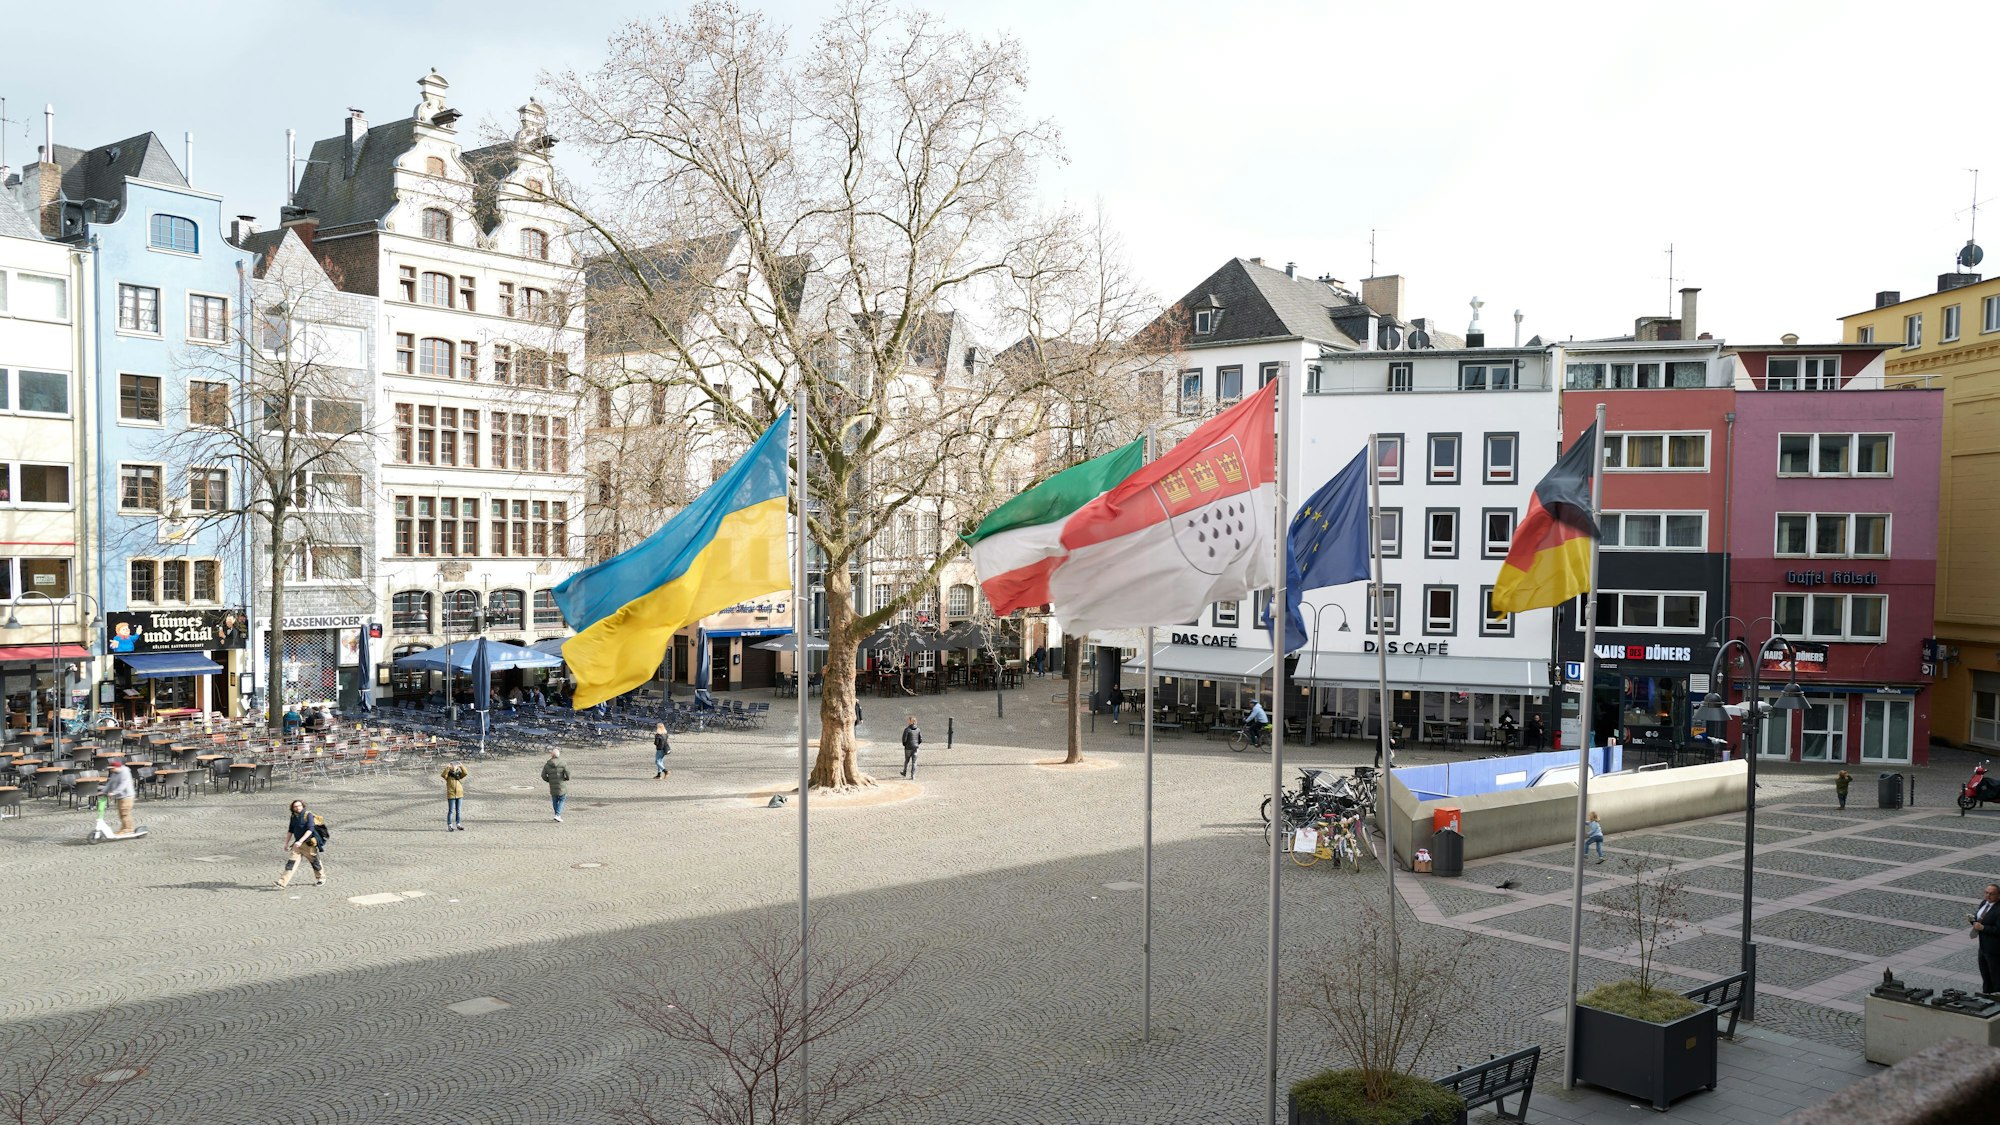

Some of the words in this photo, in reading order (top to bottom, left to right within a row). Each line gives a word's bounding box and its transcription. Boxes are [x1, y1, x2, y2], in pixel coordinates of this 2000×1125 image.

[1832, 570, 1879, 585] Kölsch
[150, 613, 203, 628] Tünnes
[268, 616, 361, 629] RASSENKICKER
[143, 629, 172, 643] und
[174, 625, 213, 642] Schäl
[1171, 632, 1199, 646] DAS
[1201, 633, 1238, 649] CAFÉ
[1403, 640, 1449, 656] CAFÉ
[1594, 644, 1626, 659] HAUS
[1645, 644, 1691, 661] DÖNERS
[1763, 650, 1784, 660] HAUS
[1795, 650, 1824, 662] DÖNERS
[1567, 664, 1580, 678] U
